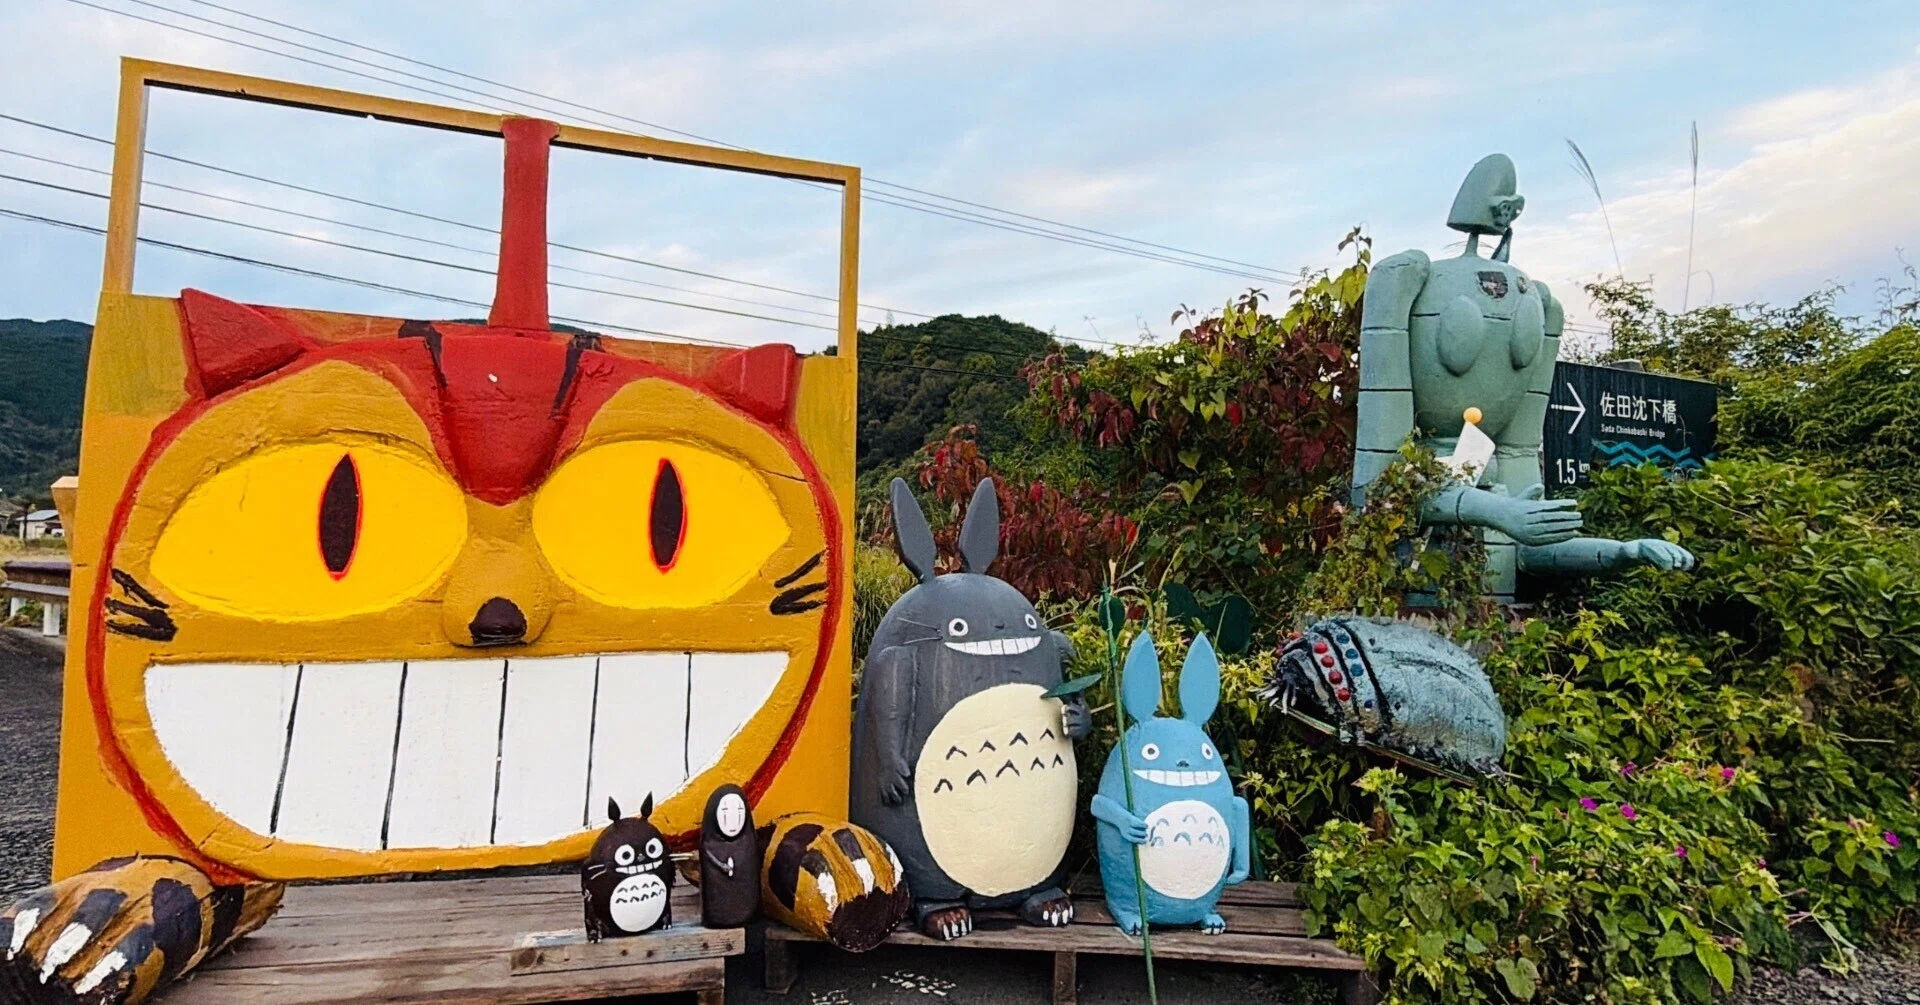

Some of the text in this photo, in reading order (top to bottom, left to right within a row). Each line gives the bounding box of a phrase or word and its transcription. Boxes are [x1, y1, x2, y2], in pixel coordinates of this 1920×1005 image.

[1600, 390, 1677, 425] 佐田沈下橋
[1601, 424, 1665, 439] Sada Chinkabashi Bridge
[1556, 458, 1590, 485] 1.5 km
